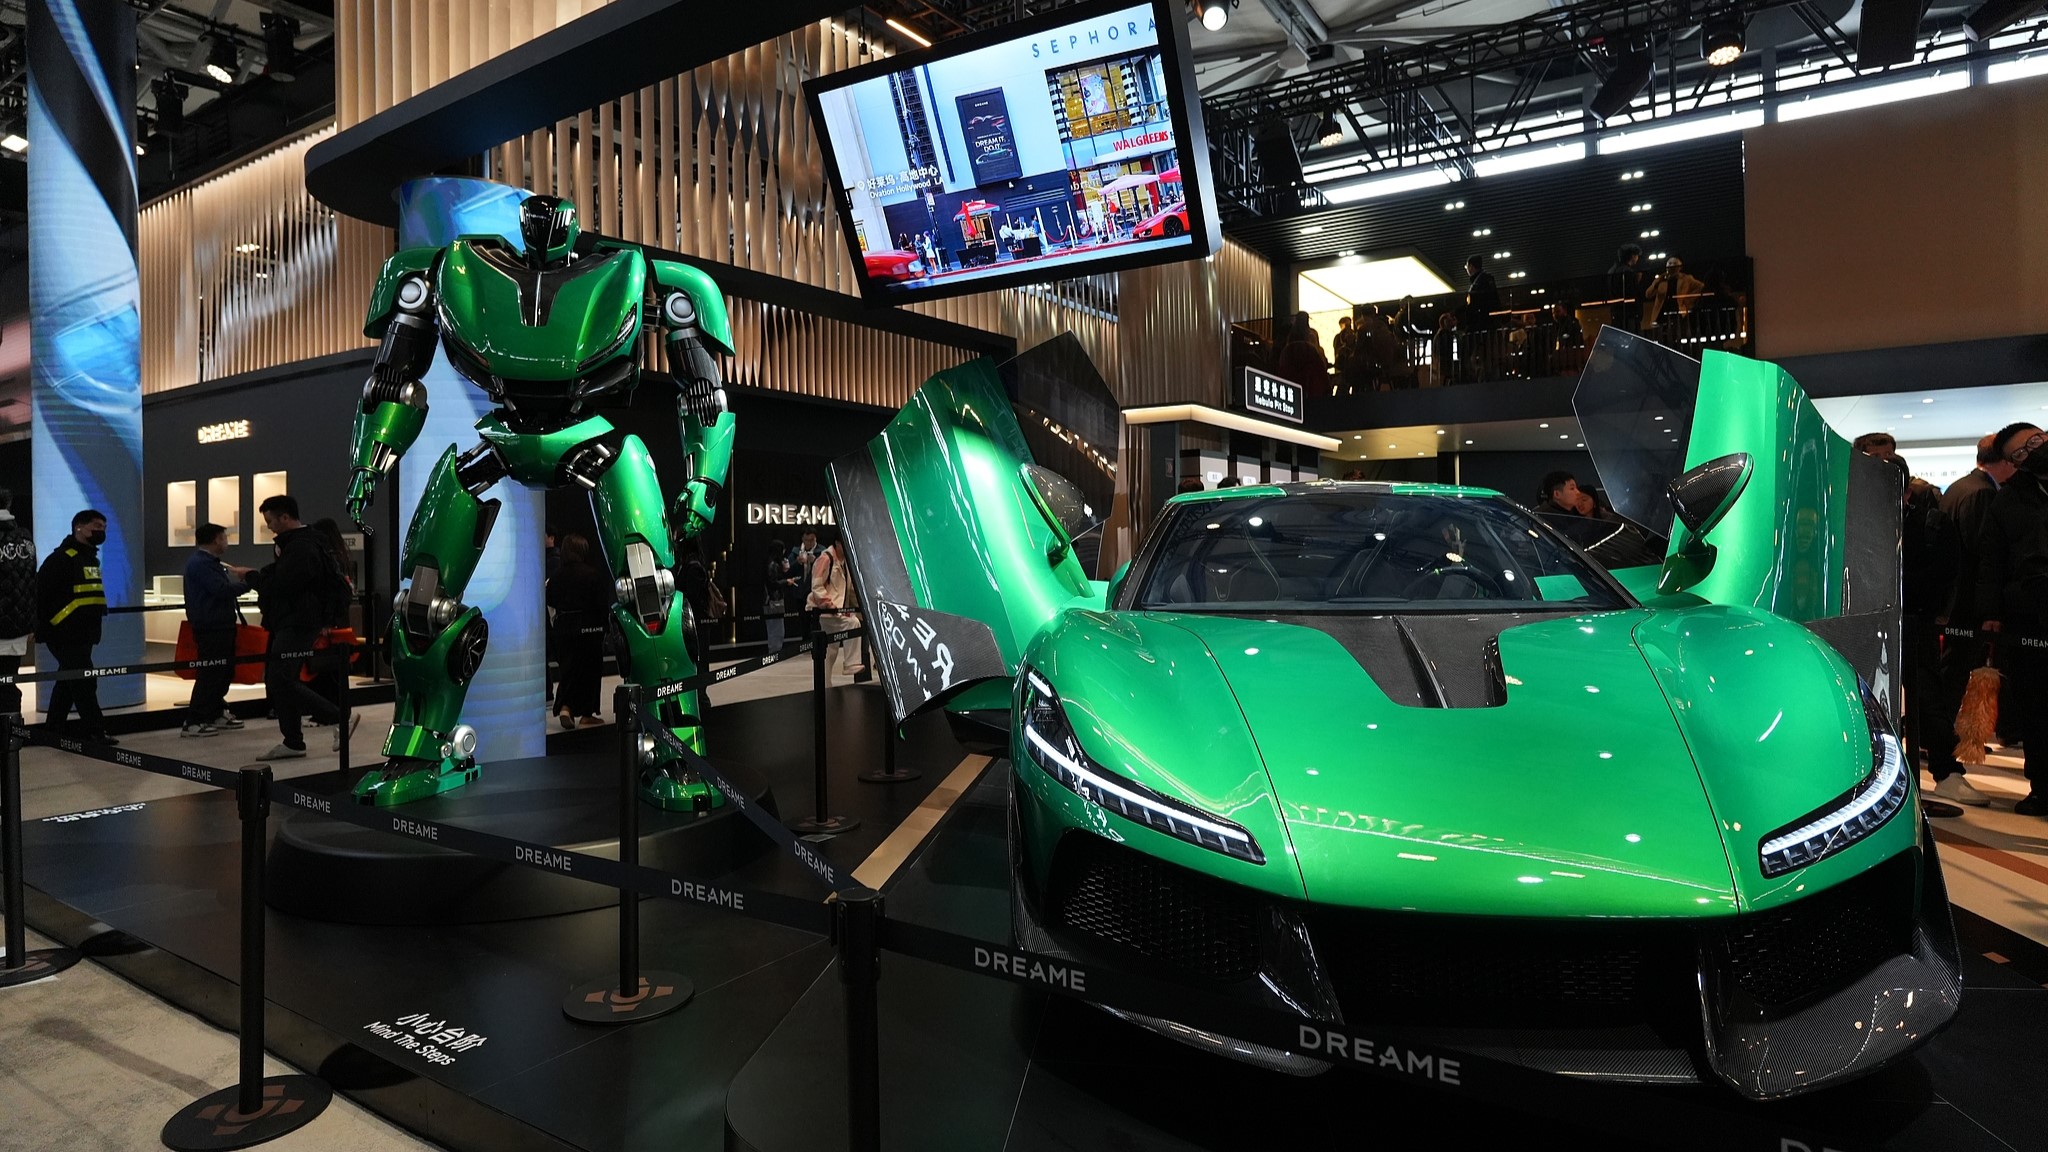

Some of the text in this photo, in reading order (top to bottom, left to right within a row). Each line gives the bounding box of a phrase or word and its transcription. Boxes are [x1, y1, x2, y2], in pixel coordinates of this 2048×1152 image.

[1032, 17, 1156, 58] SEPHORA
[975, 138, 998, 148] DREAM
[984, 145, 995, 153] DO
[1113, 131, 1169, 151] WALGREENS
[869, 177, 945, 199] Ovation Hollywood LA
[1274, 399, 1282, 411] Pit
[1283, 402, 1294, 415] Stop
[1945, 627, 1974, 637] DREAME
[189, 659, 227, 667] DREAME
[281, 650, 314, 659] DREAME
[762, 653, 779, 666] DREAME
[84, 667, 128, 677] DREAME
[716, 667, 737, 681] DREAME
[657, 682, 683, 698] DREAME
[60, 738, 82, 752] DREAME
[116, 752, 142, 766] DREAME
[182, 765, 212, 782] DREAME
[716, 776, 746, 810] DREAME
[293, 793, 331, 814] DREAME
[393, 818, 438, 841] DREAME
[514, 846, 572, 872] DREAME
[794, 840, 834, 884] DREAME
[671, 879, 744, 910] DREAME
[974, 946, 1086, 992] DREAME
[395, 1013, 487, 1052] 小心台阶
[363, 1021, 456, 1066] Mind The Steps
[1299, 1024, 1461, 1086] DREAME
